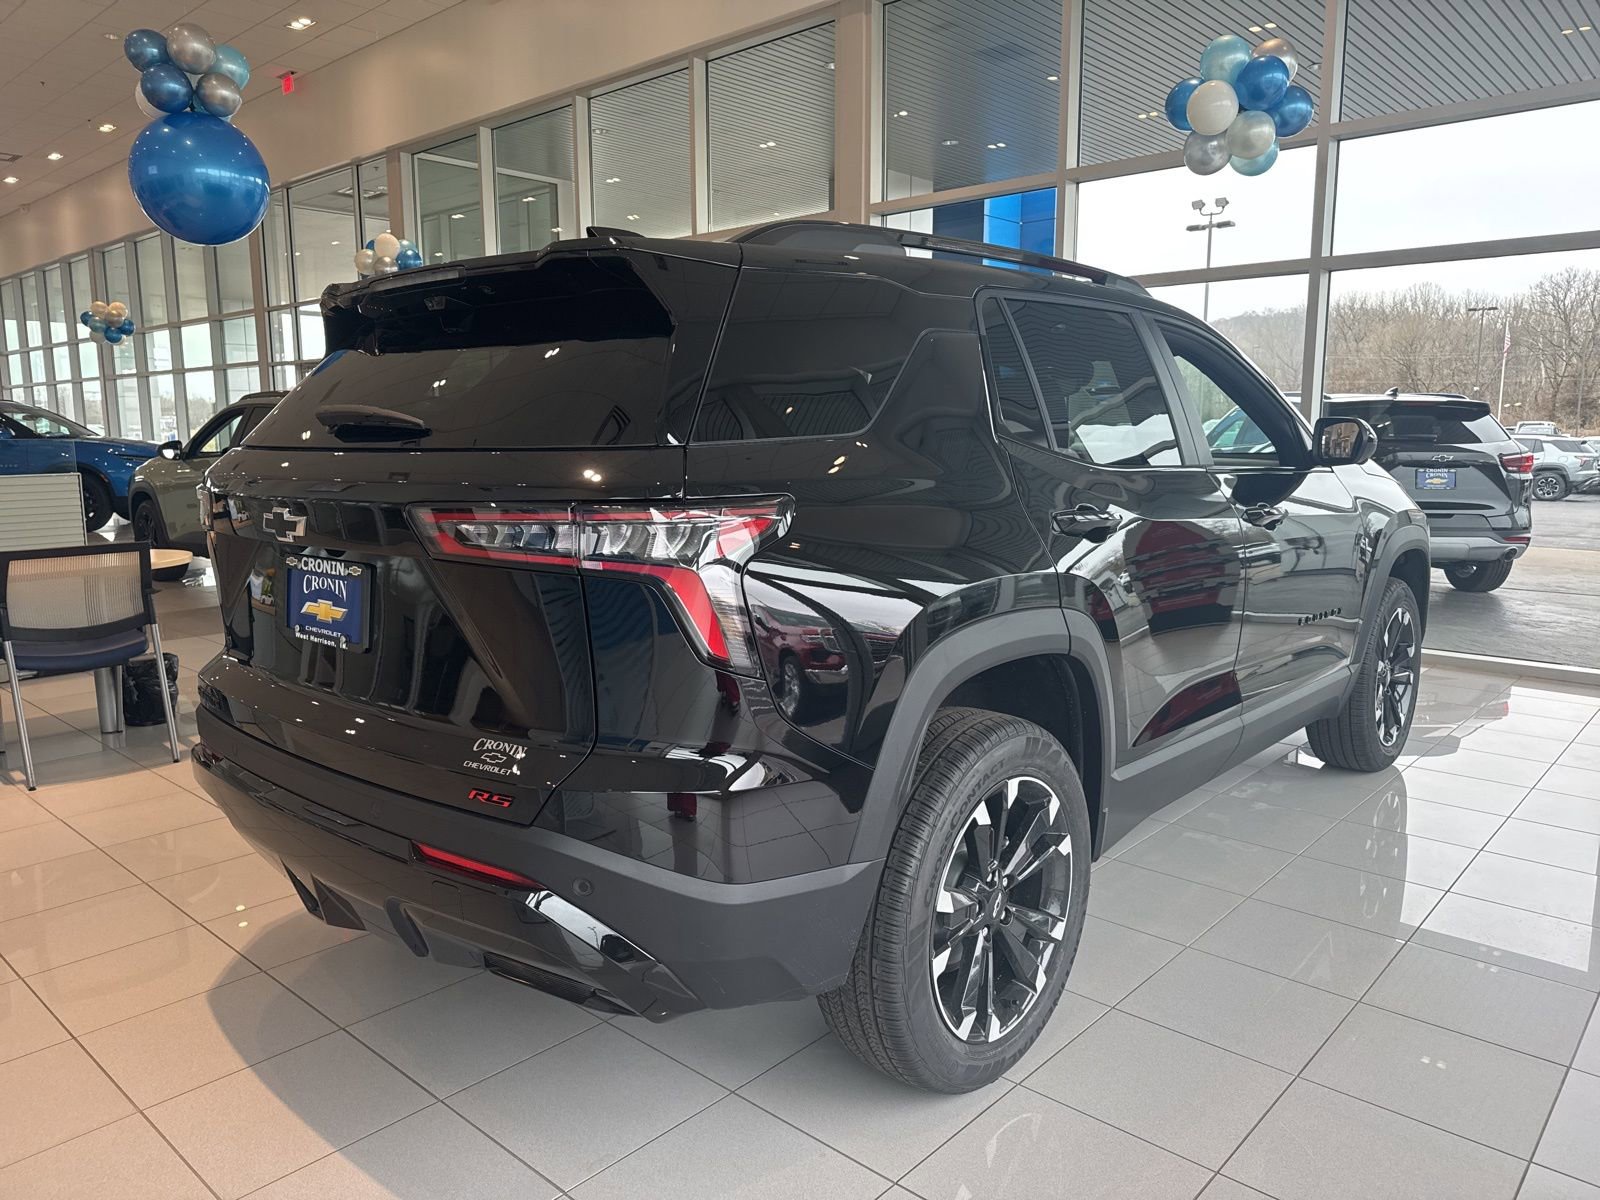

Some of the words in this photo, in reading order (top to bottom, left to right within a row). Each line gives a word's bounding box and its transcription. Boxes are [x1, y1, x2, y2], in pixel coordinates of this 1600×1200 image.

[301, 557, 345, 576] CRONIN
[303, 574, 347, 602] CRONIN
[295, 632, 309, 641] West
[305, 625, 342, 638] CHEVROLET
[473, 737, 528, 759] CRONIN
[463, 760, 512, 776] CHEVROLET
[468, 788, 513, 808] RS
